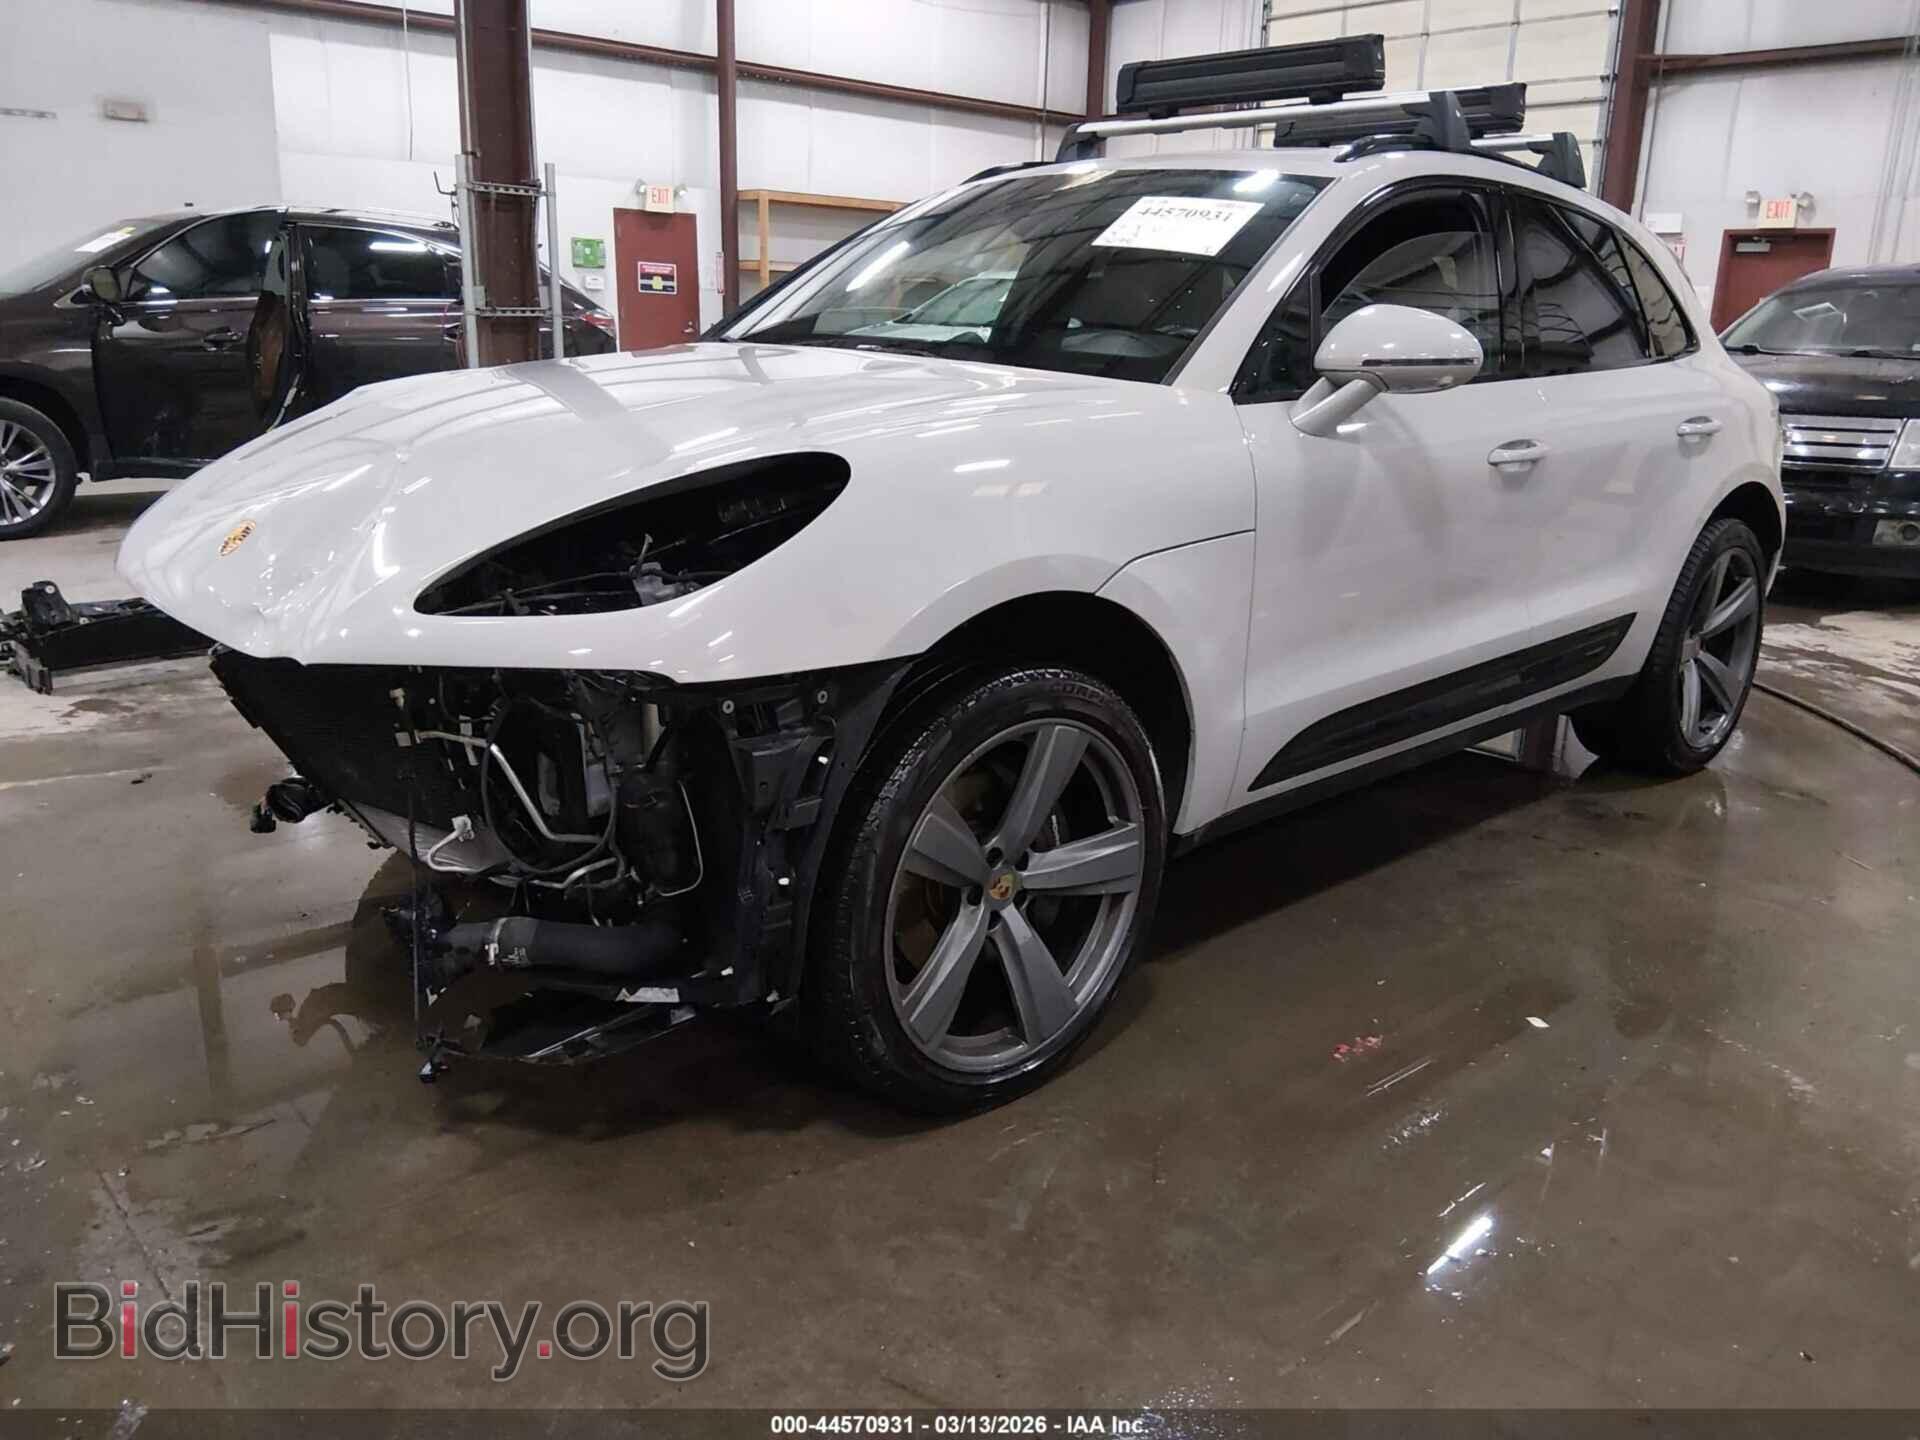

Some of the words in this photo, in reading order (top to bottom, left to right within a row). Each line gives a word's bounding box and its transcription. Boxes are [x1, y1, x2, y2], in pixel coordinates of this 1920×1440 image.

[651, 187, 670, 204] EXIT
[1138, 206, 1234, 222] 44570931
[1766, 199, 1792, 219] EXIT
